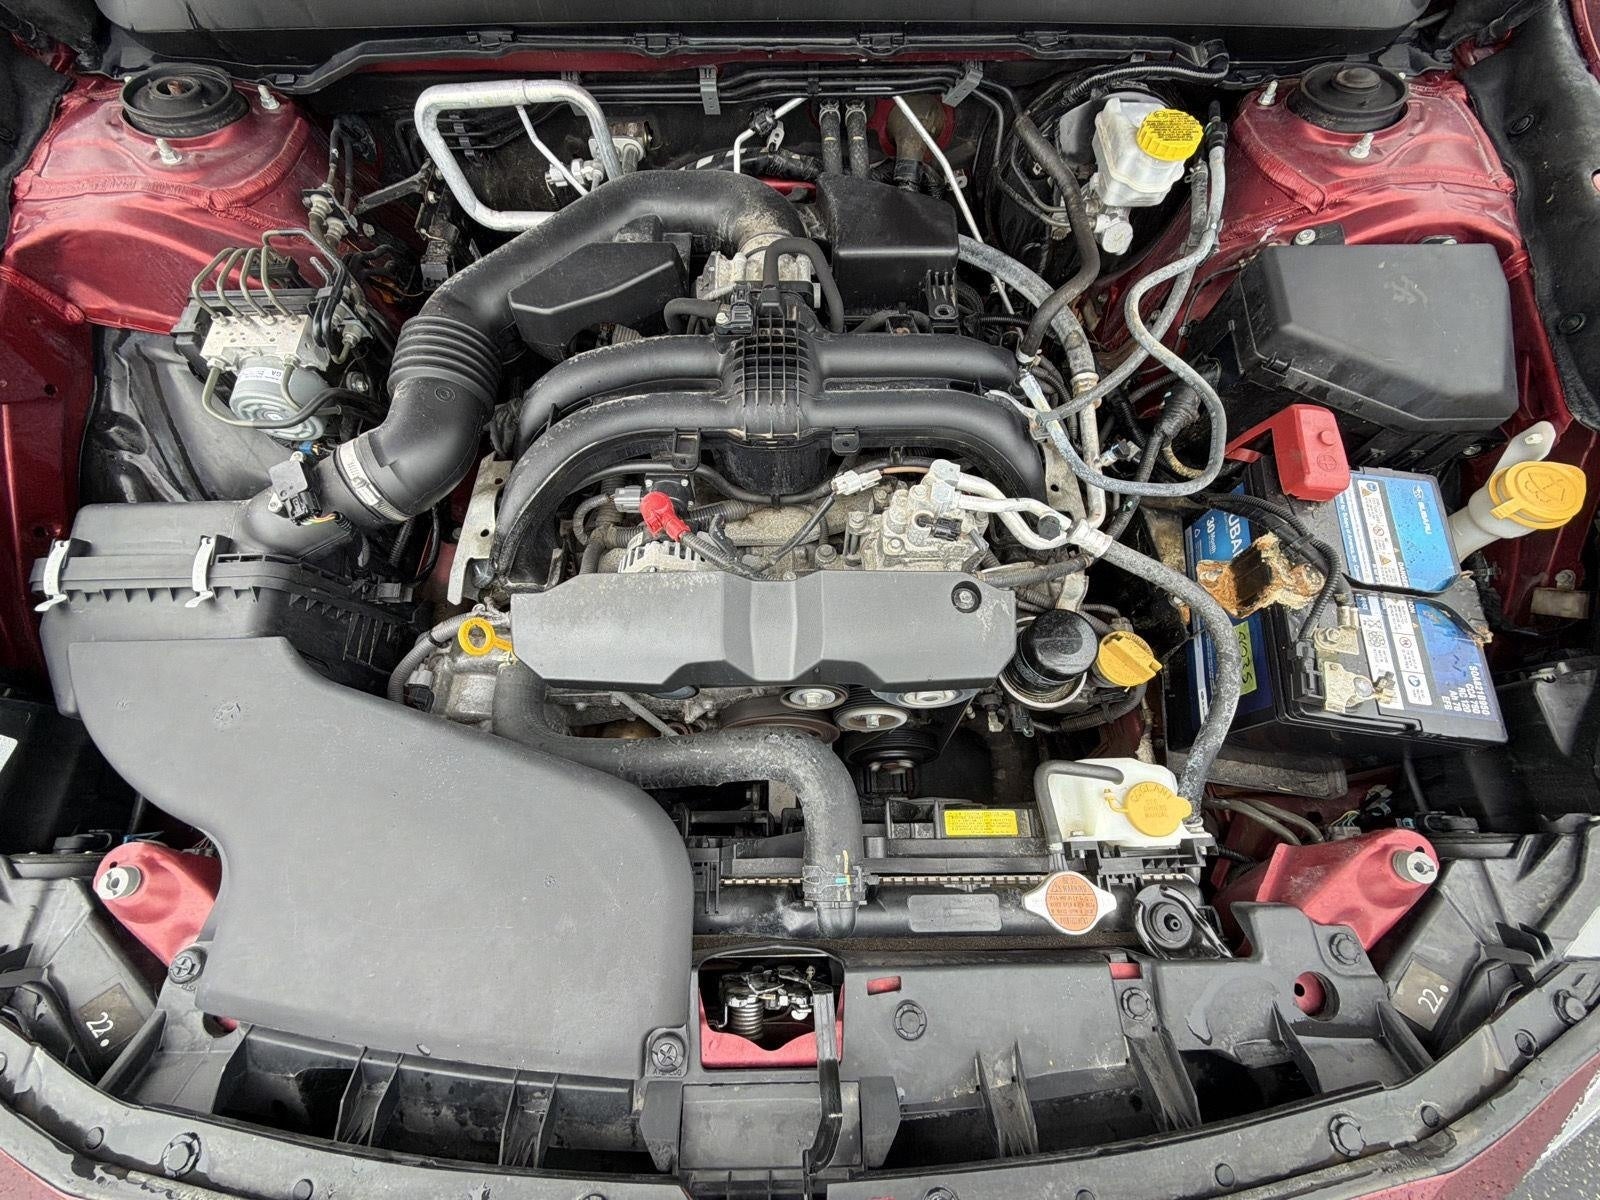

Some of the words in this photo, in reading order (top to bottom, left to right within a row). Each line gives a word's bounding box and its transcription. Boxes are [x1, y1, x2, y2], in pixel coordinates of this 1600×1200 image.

[1206, 516, 1216, 533] 30
[1418, 502, 1432, 535] SUBARU
[1398, 561, 1410, 587] DANGER
[1465, 683, 1477, 699] CCA
[1462, 699, 1472, 713] 120
